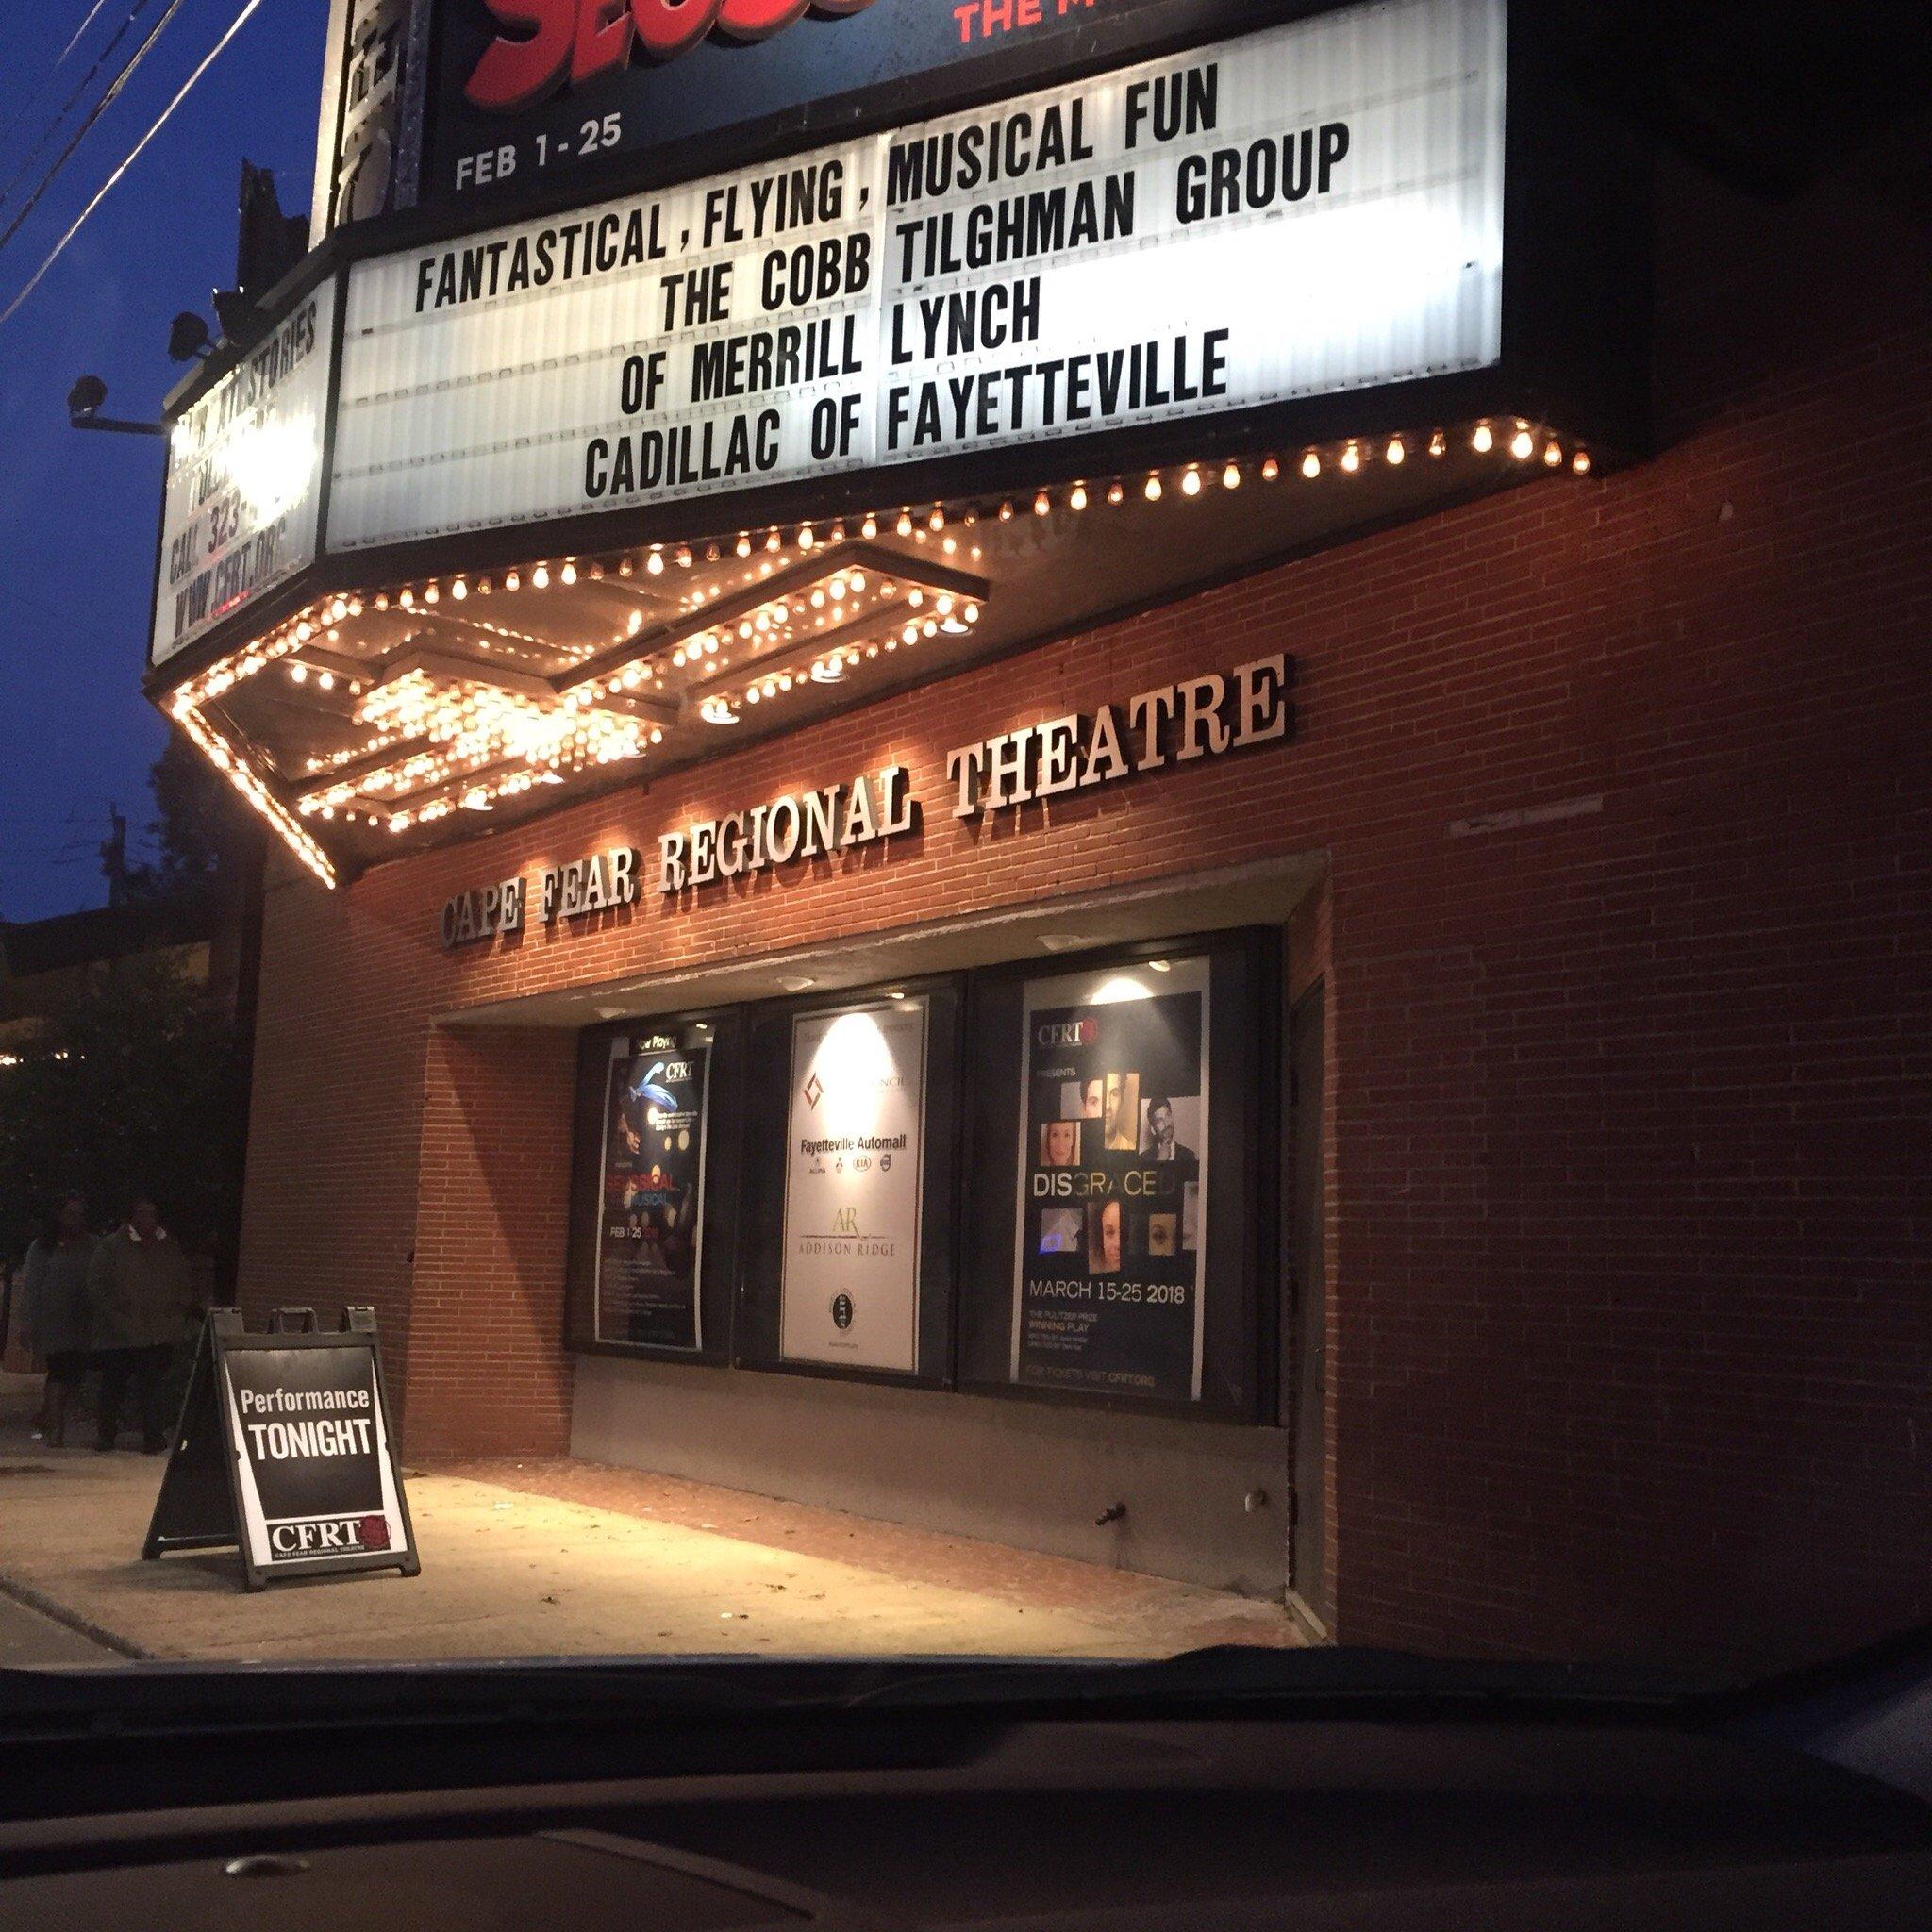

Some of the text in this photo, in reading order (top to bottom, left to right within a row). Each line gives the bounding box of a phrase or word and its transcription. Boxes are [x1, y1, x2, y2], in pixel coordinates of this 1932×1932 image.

[954, 0, 1041, 43] THE
[887, 98, 1093, 207] MUSICAL
[1124, 63, 1219, 149] FUN
[456, 144, 516, 191] FEB
[660, 122, 1350, 331] THE COBB TILGHMAN GROUP
[621, 276, 1041, 415] OF MERRILL LYNCH
[584, 327, 1230, 498] CADILLAC OF FAYETTEVILLE
[440, 653, 1289, 946] CAPE FEAR REGIONAL THEATRE
[1038, 1021, 1084, 1045] CFRT
[801, 1133, 907, 1156] Fayetteville Automall
[1033, 1170, 1176, 1197] DISGRCED
[798, 1241, 896, 1257] ADDISON RIDGE
[1029, 1279, 1186, 1305] MARCH 15-25 2018
[240, 1387, 371, 1461] Performance TONIGHT
[272, 1519, 361, 1552] CFRT
